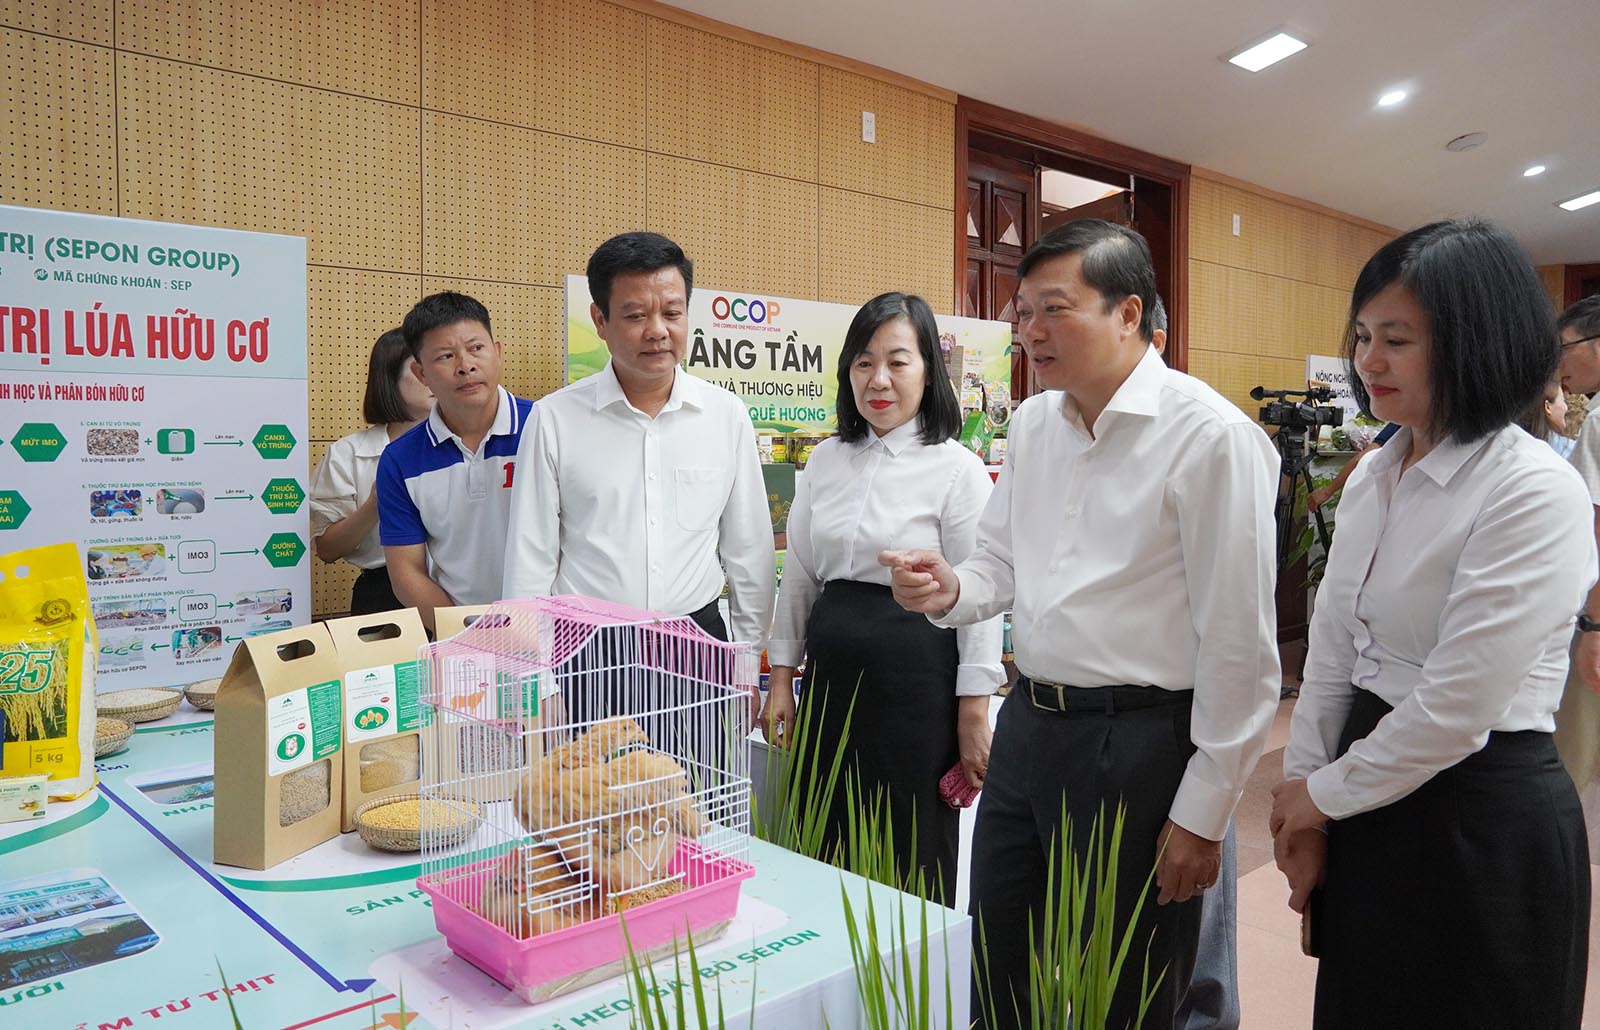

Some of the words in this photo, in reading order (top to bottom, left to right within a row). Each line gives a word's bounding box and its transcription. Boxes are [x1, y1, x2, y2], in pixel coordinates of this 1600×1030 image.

[44, 236, 139, 264] (SEPON
[147, 246, 240, 278] GROUP)
[53, 270, 74, 283] MÃ
[76, 272, 118, 286] CHỨNG
[121, 275, 161, 290] KHOÁN
[171, 280, 192, 291] SEP
[711, 295, 781, 325] OCOP
[64, 302, 136, 359] LÚA
[146, 307, 215, 362] HỮU
[226, 316, 270, 364] CƠ
[688, 328, 757, 372] ÂNG
[765, 331, 823, 373] TẦM
[1315, 369, 1333, 383] NÔNG
[13, 383, 35, 404] HỌC
[38, 381, 52, 401] VÀ
[55, 381, 83, 401] PHÂN
[86, 382, 107, 402] BÓN
[132, 385, 145, 402] CƠ
[740, 381, 794, 396] THƯƠNG
[797, 380, 823, 400] HIỆU
[749, 403, 776, 421] QUÊ
[780, 407, 826, 422] HƯƠNG
[187, 551, 209, 560] IMO3
[187, 602, 209, 611] IMO3
[35, 754, 43, 763] 5
[48, 753, 64, 763] kg
[198, 972, 277, 1002] THỊT
[570, 998, 638, 1027] HEO
[737, 929, 821, 964] SEPON
